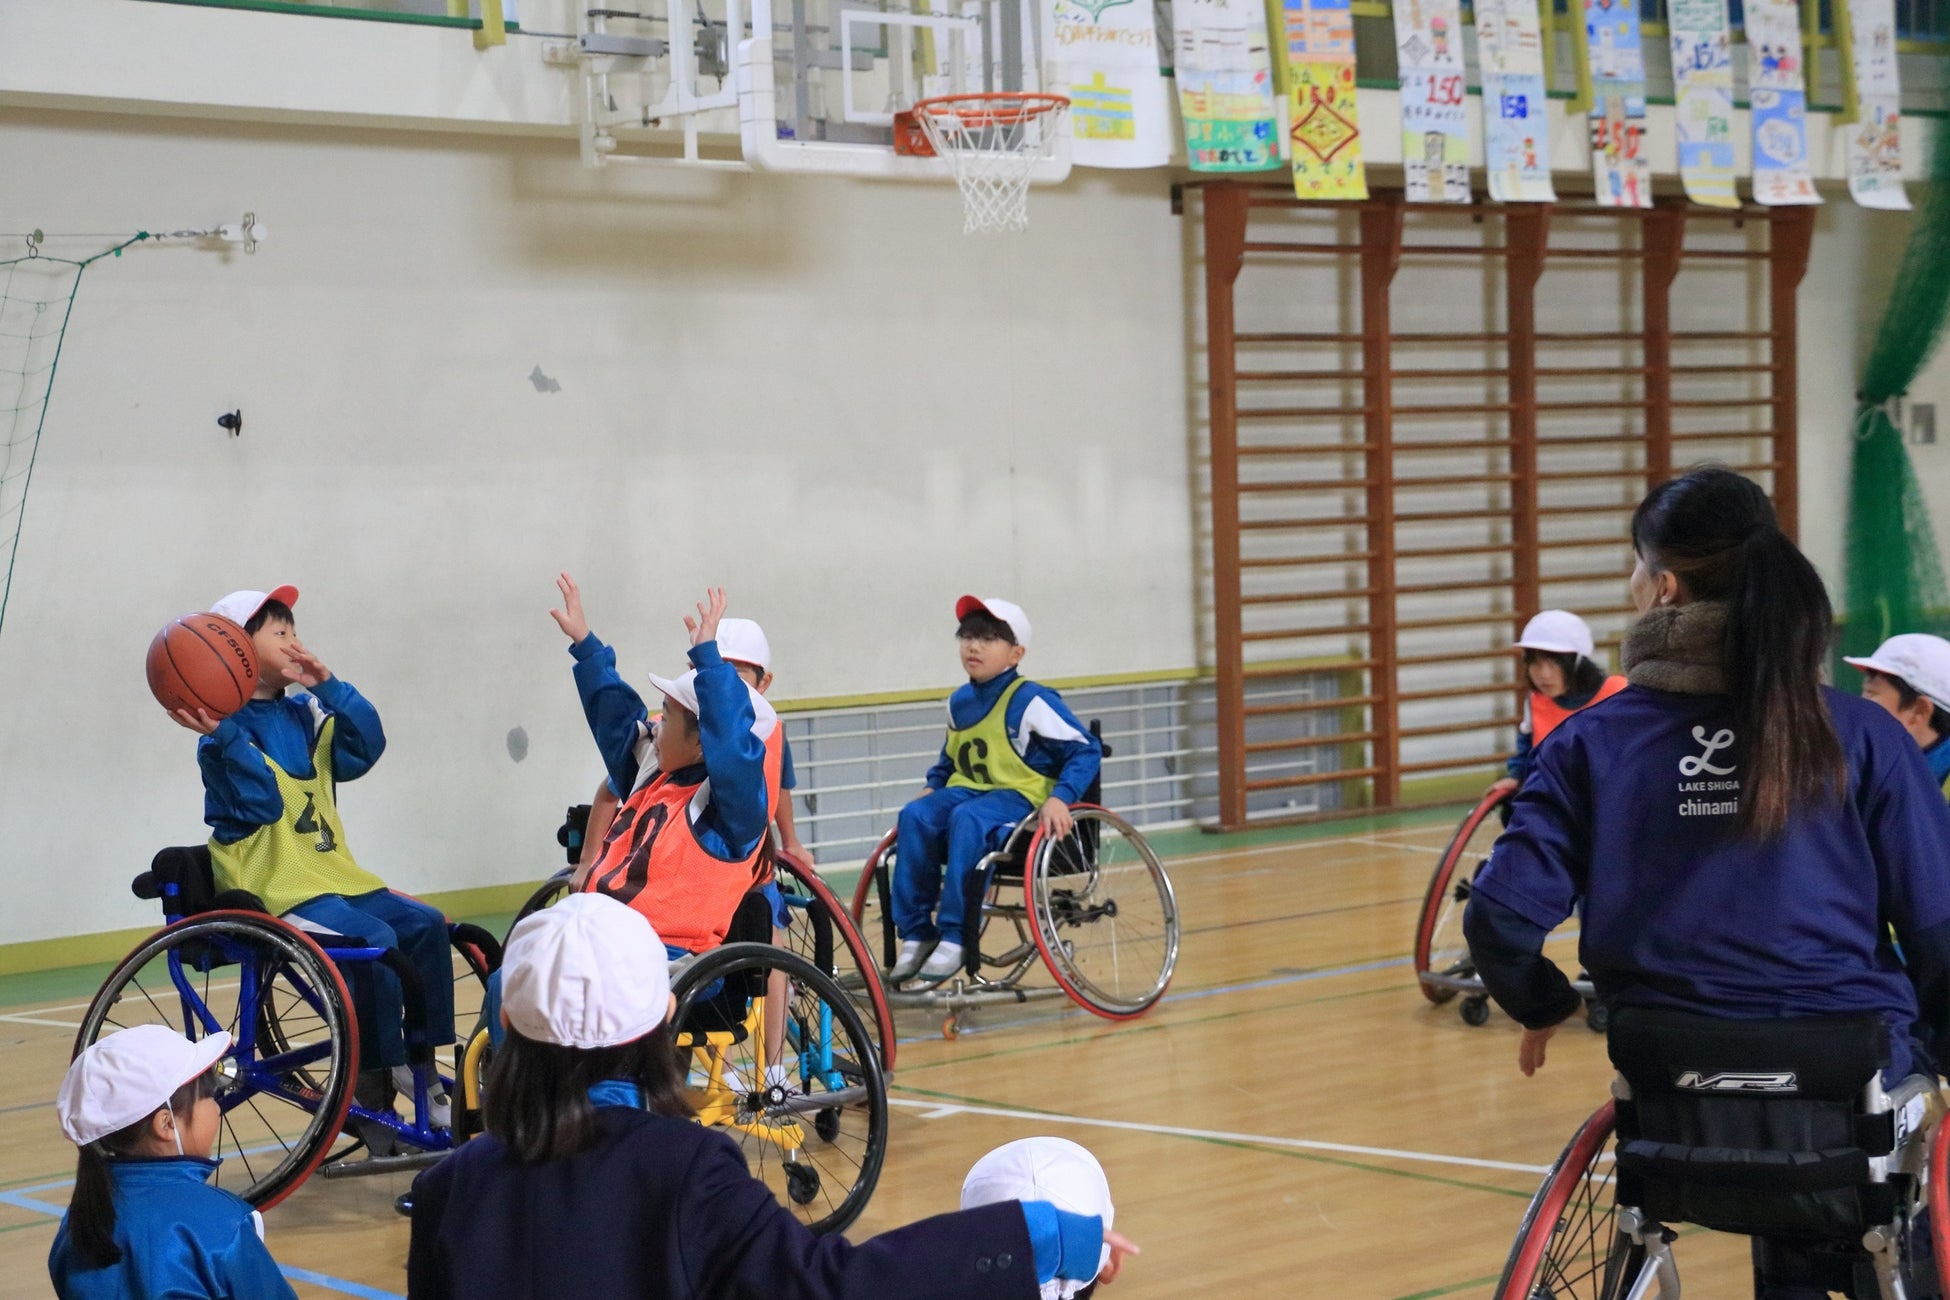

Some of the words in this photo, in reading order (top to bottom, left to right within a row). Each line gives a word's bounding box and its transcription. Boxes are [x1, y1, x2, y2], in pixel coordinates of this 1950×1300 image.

[1298, 85, 1335, 106] 150
[1427, 74, 1465, 106] 150
[1597, 117, 1640, 159] 150
[1678, 782, 1706, 792] LAKE
[1707, 780, 1740, 791] SHIGA
[1678, 797, 1738, 816] chinami
